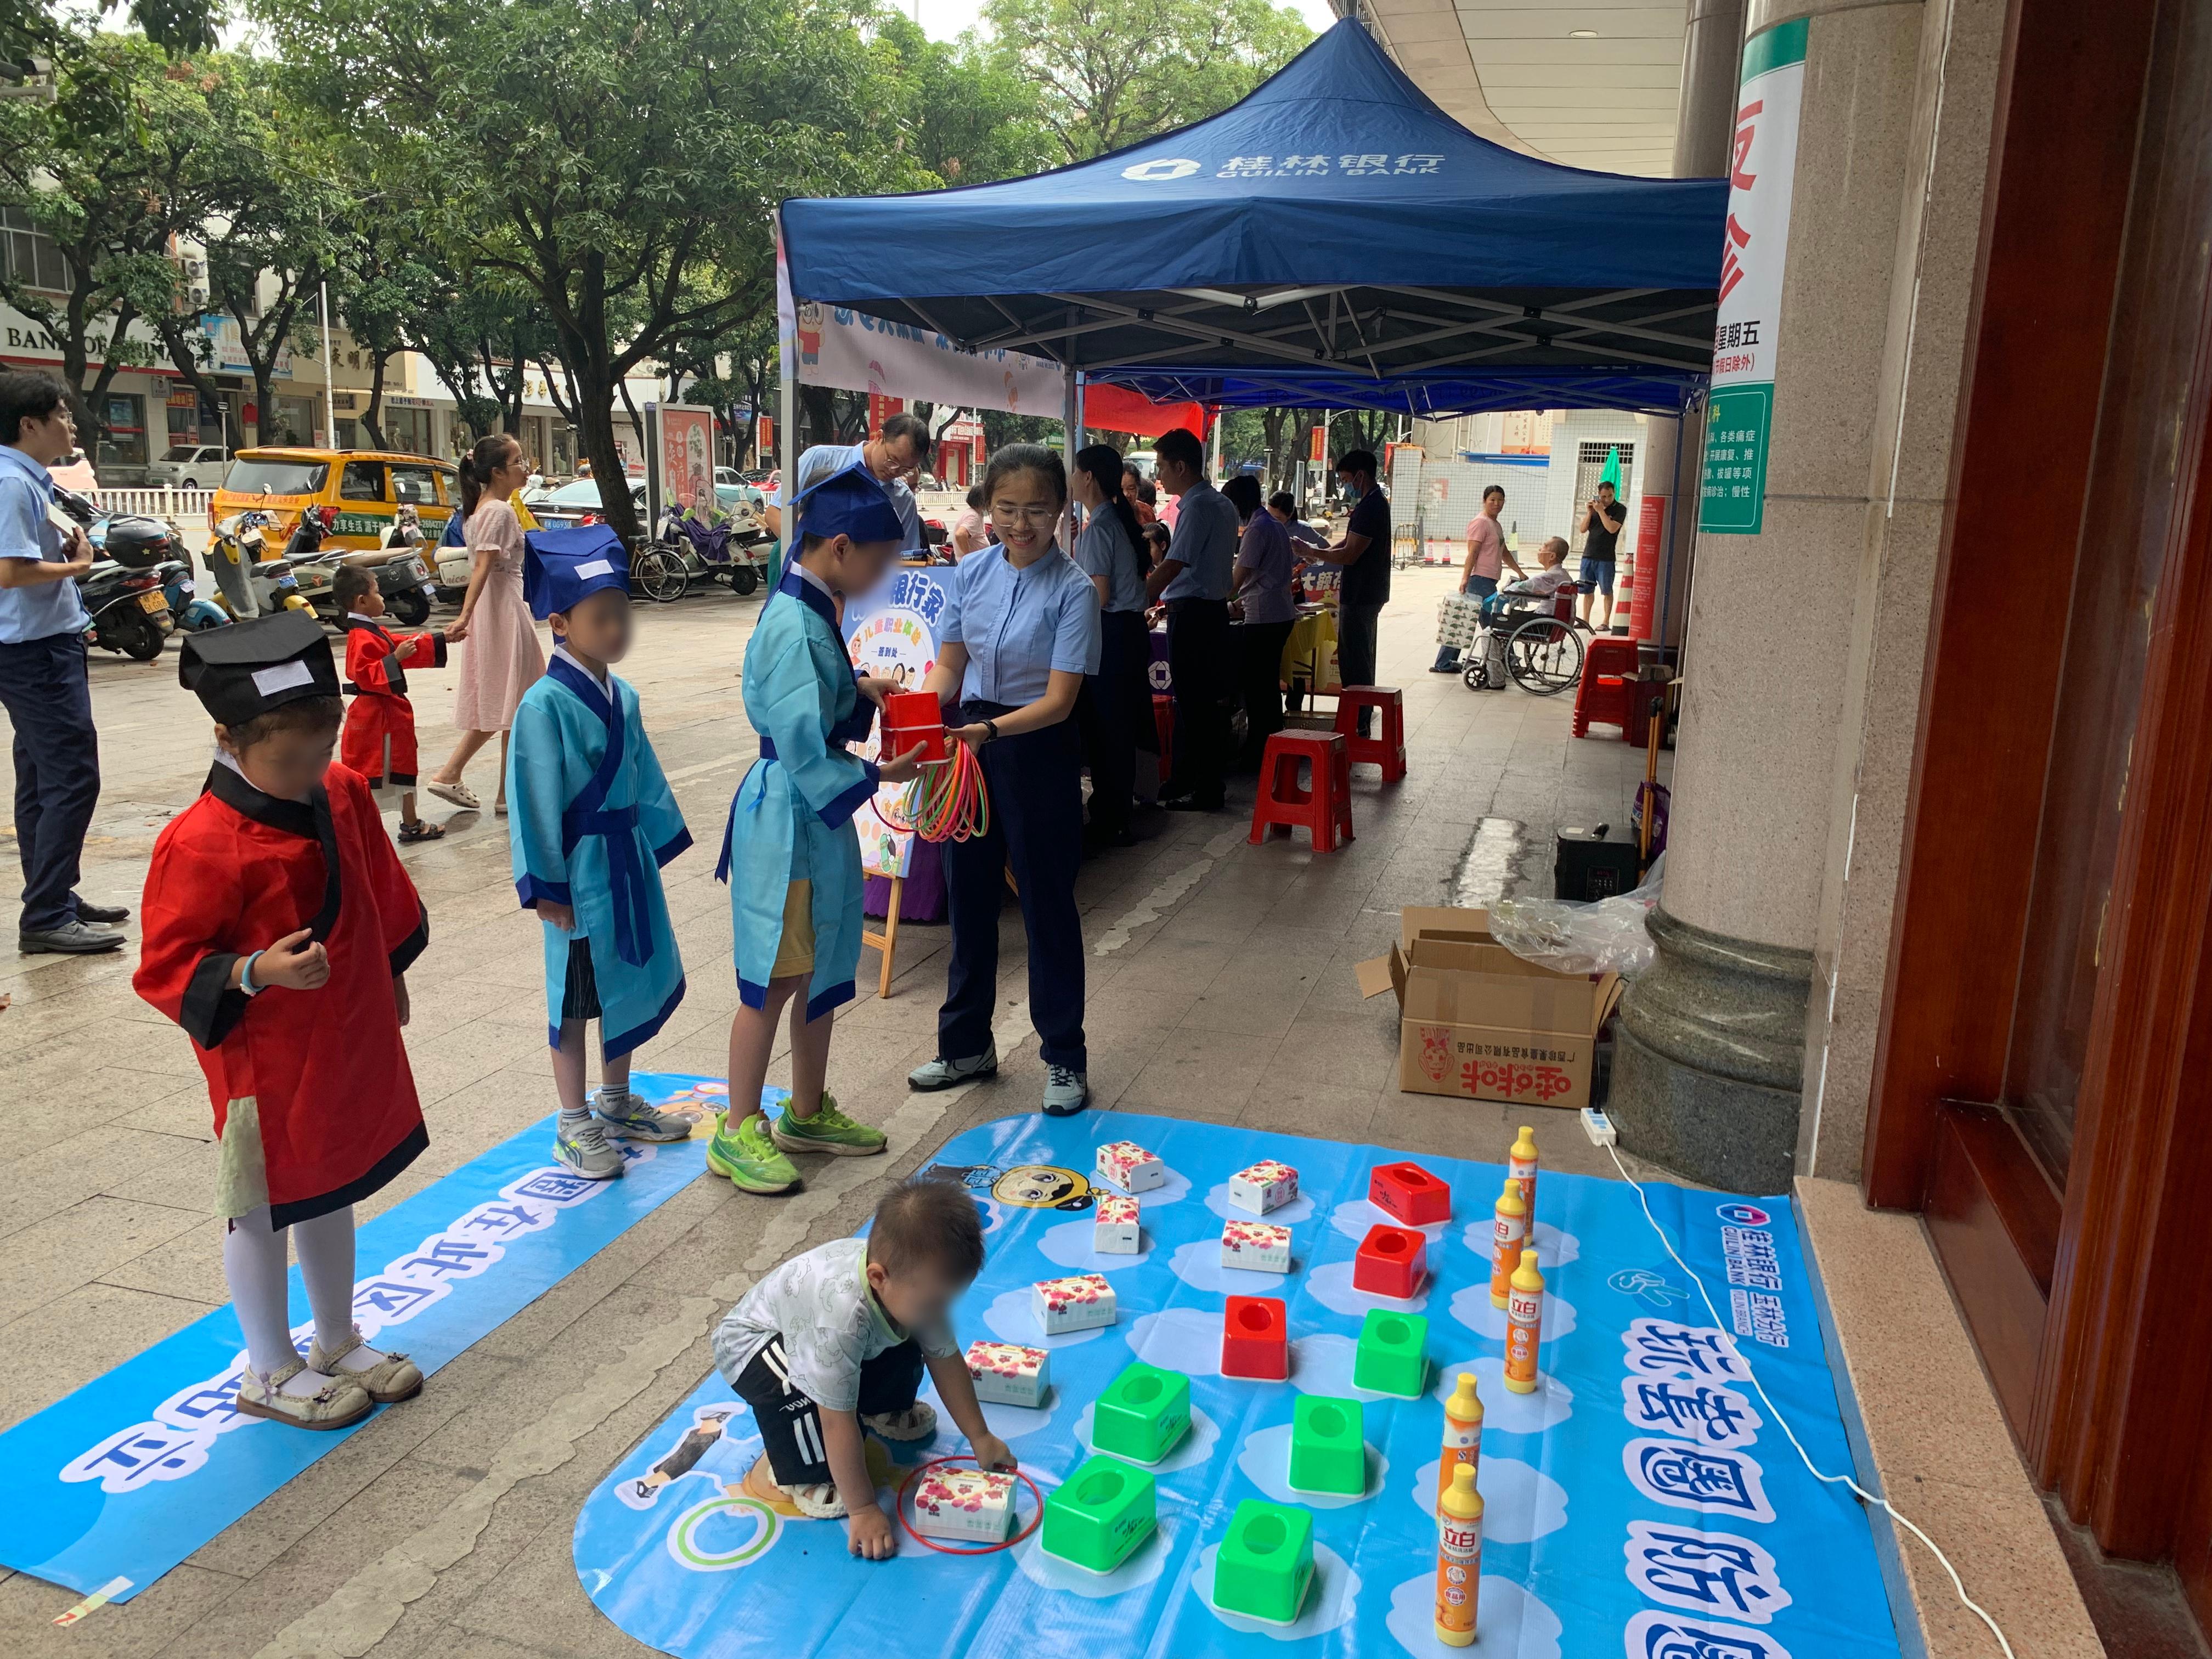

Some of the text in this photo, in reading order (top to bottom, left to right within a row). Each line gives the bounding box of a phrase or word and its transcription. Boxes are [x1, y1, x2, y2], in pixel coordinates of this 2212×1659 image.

[1216, 167, 1443, 179] GUILIN BANK
[1222, 154, 1447, 172] 桂林银行
[7, 328, 63, 351] BAN
[1713, 320, 1760, 354] 星期五
[864, 617, 922, 647] 儿童职业体验
[878, 646, 898, 658] 签到处
[1460, 1059, 1572, 1101] 哇咔咔
[1724, 1227, 1740, 1257] GUILIN
[1728, 1258, 1746, 1285] BANK
[1741, 1229, 1785, 1346] 桂林银行 玉林分行
[83, 1145, 645, 1481] 圈在此区站立
[1511, 1298, 1537, 1314] 立白
[1443, 1526, 1475, 1548] 立白
